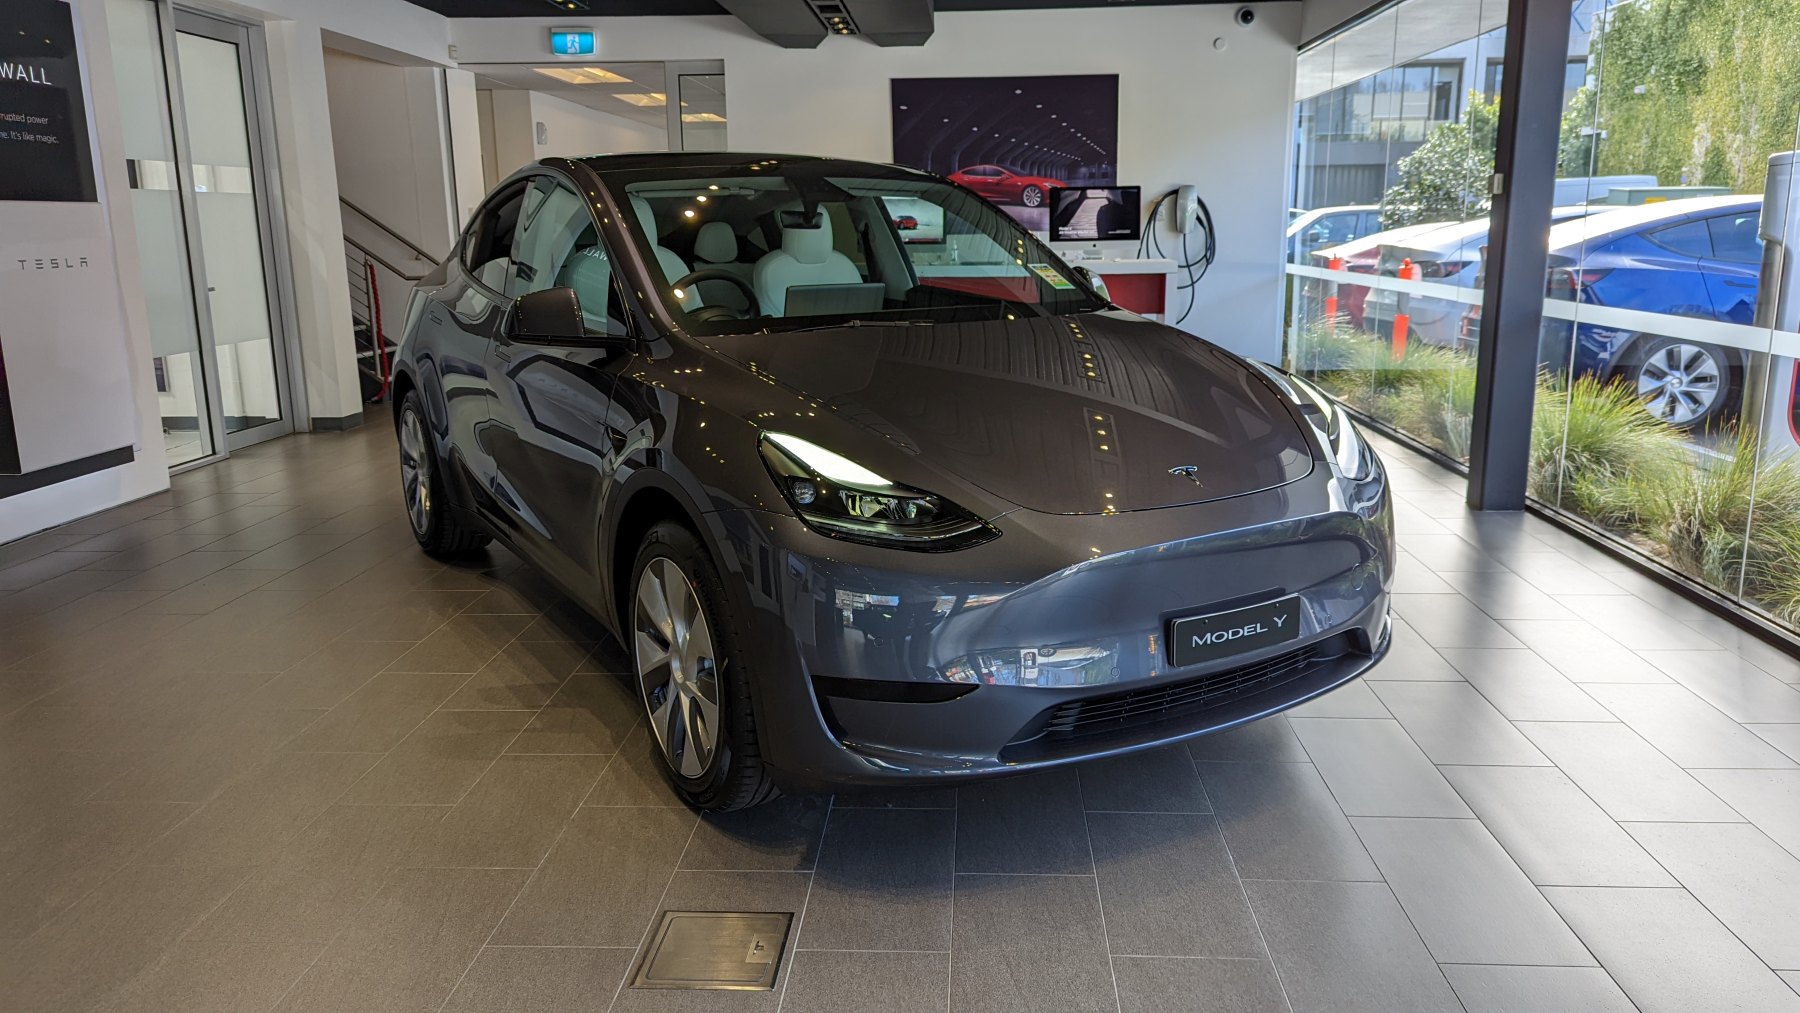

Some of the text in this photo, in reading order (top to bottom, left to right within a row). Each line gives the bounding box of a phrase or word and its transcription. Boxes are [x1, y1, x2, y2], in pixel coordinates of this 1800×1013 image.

[0, 62, 52, 85] WALL
[27, 116, 48, 125] power
[11, 131, 22, 140] It's
[22, 131, 35, 141] like
[36, 134, 60, 144] magic.
[17, 257, 88, 270] TESLA
[1192, 614, 1288, 648] MODEL Y
